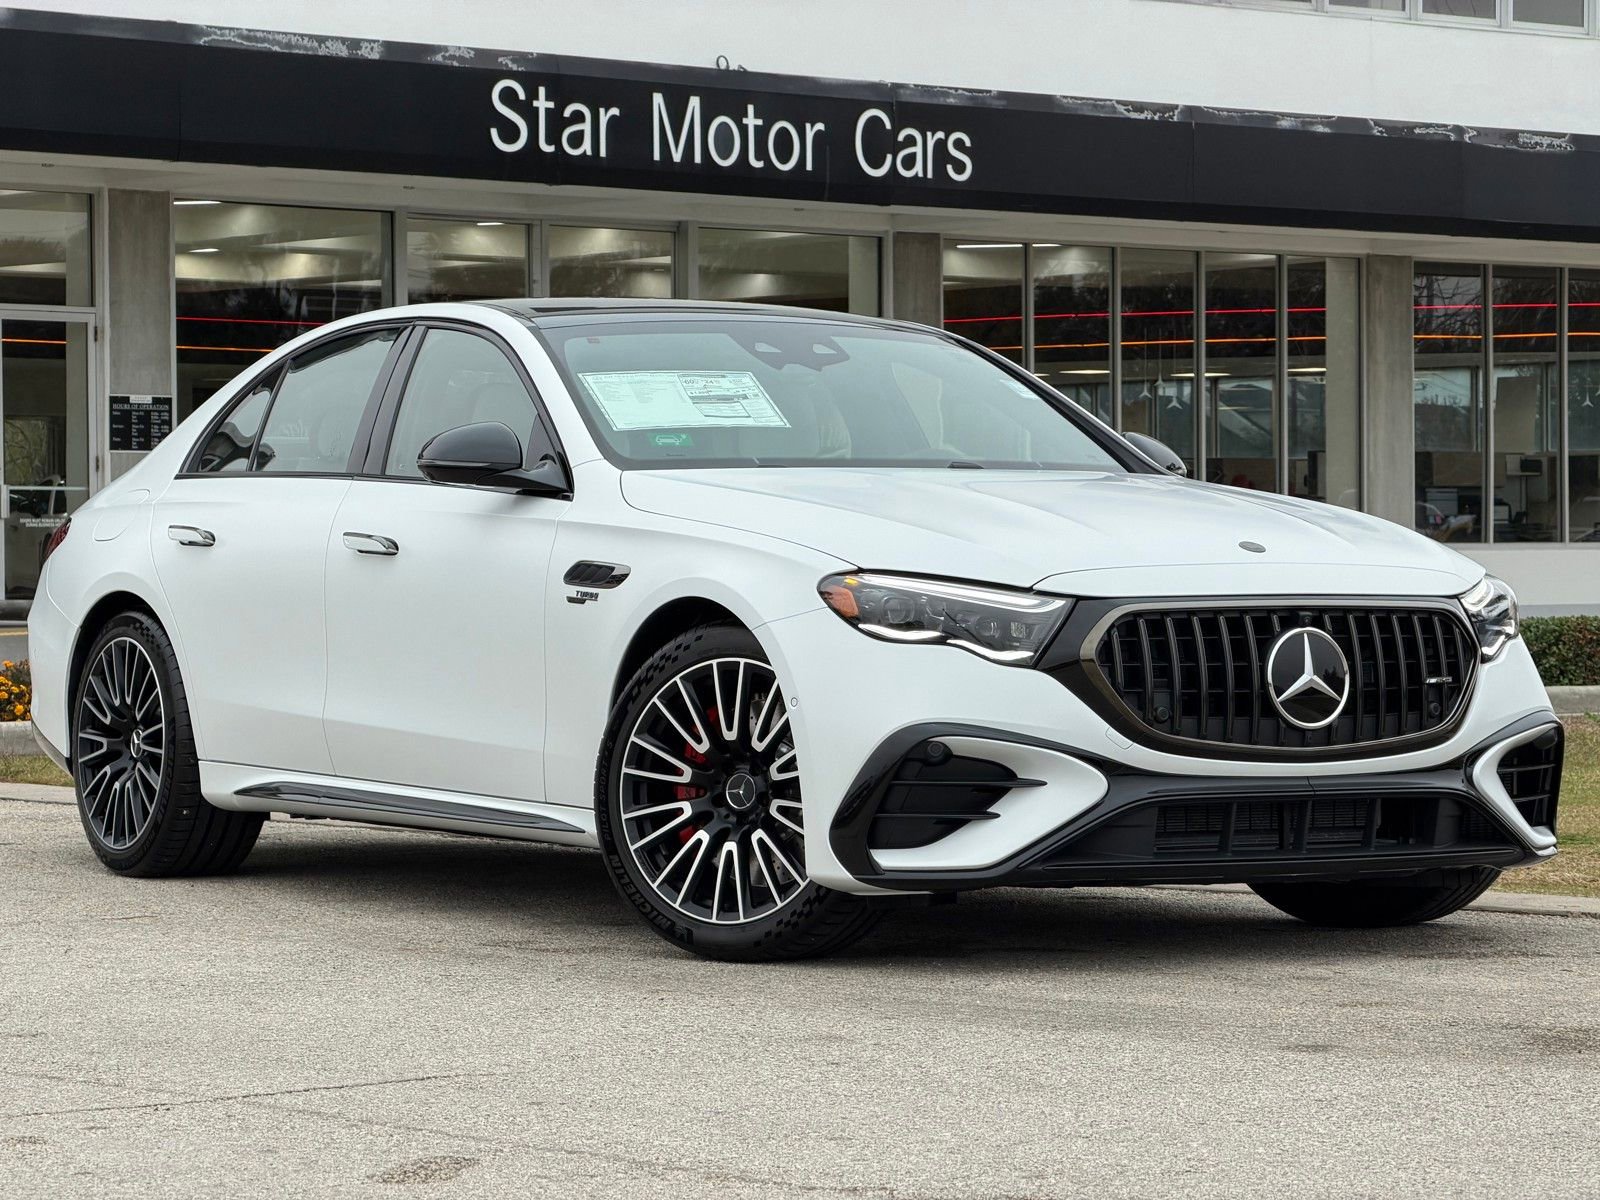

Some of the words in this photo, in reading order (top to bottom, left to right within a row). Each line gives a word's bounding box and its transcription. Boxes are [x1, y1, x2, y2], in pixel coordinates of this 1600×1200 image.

[490, 79, 620, 158] Star
[652, 92, 826, 172] Motor
[855, 108, 973, 182] Cars
[575, 590, 600, 600] TURBO
[597, 760, 609, 801] SPORT
[599, 806, 612, 842] PILOT
[608, 854, 675, 931] MICHELIN
